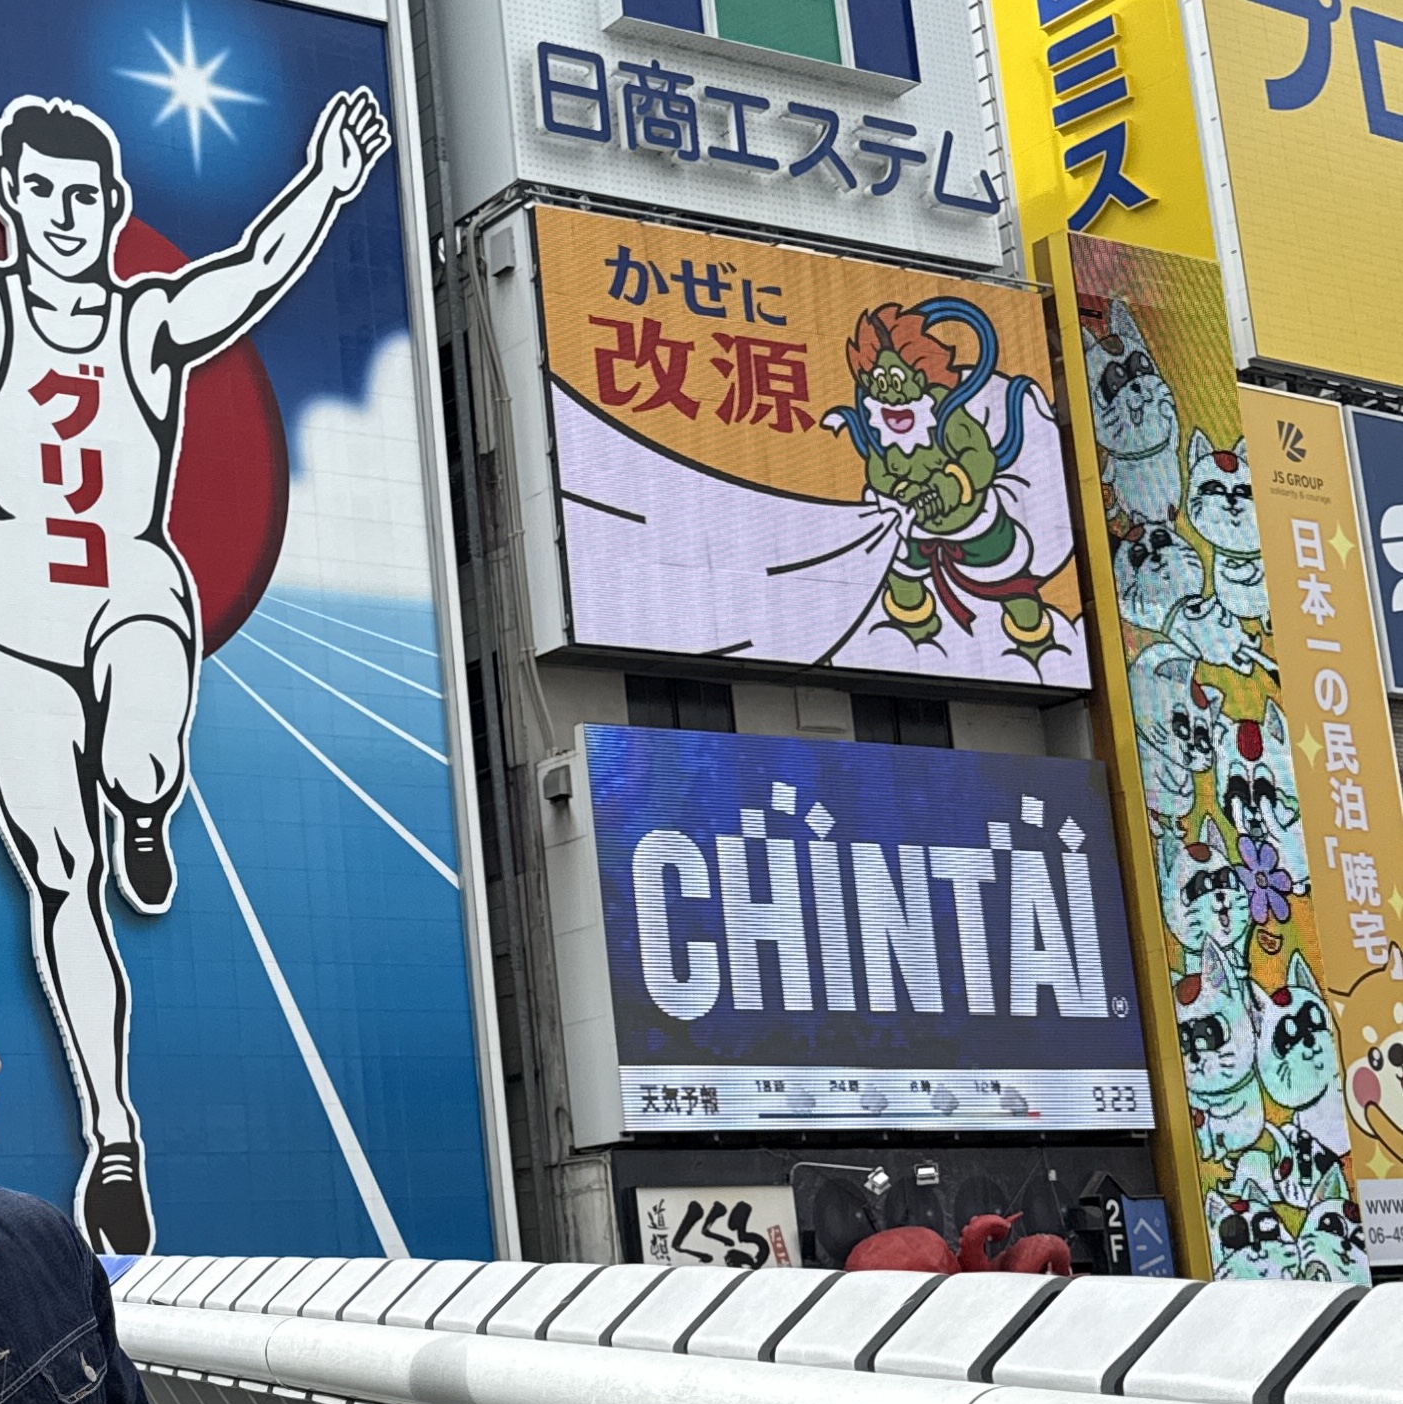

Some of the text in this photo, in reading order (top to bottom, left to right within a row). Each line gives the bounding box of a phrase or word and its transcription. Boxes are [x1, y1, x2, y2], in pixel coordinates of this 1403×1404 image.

[536, 41, 1001, 217] 日商エステム
[606, 245, 787, 328] かぜに
[589, 315, 817, 434] 改源
[28, 364, 110, 588] グリコ
[1272, 470, 1324, 490] JS GROUP
[632, 795, 1109, 1021] CHINTAI
[640, 1084, 719, 1115] 天気予報
[1105, 1198, 1124, 1263] 2F
